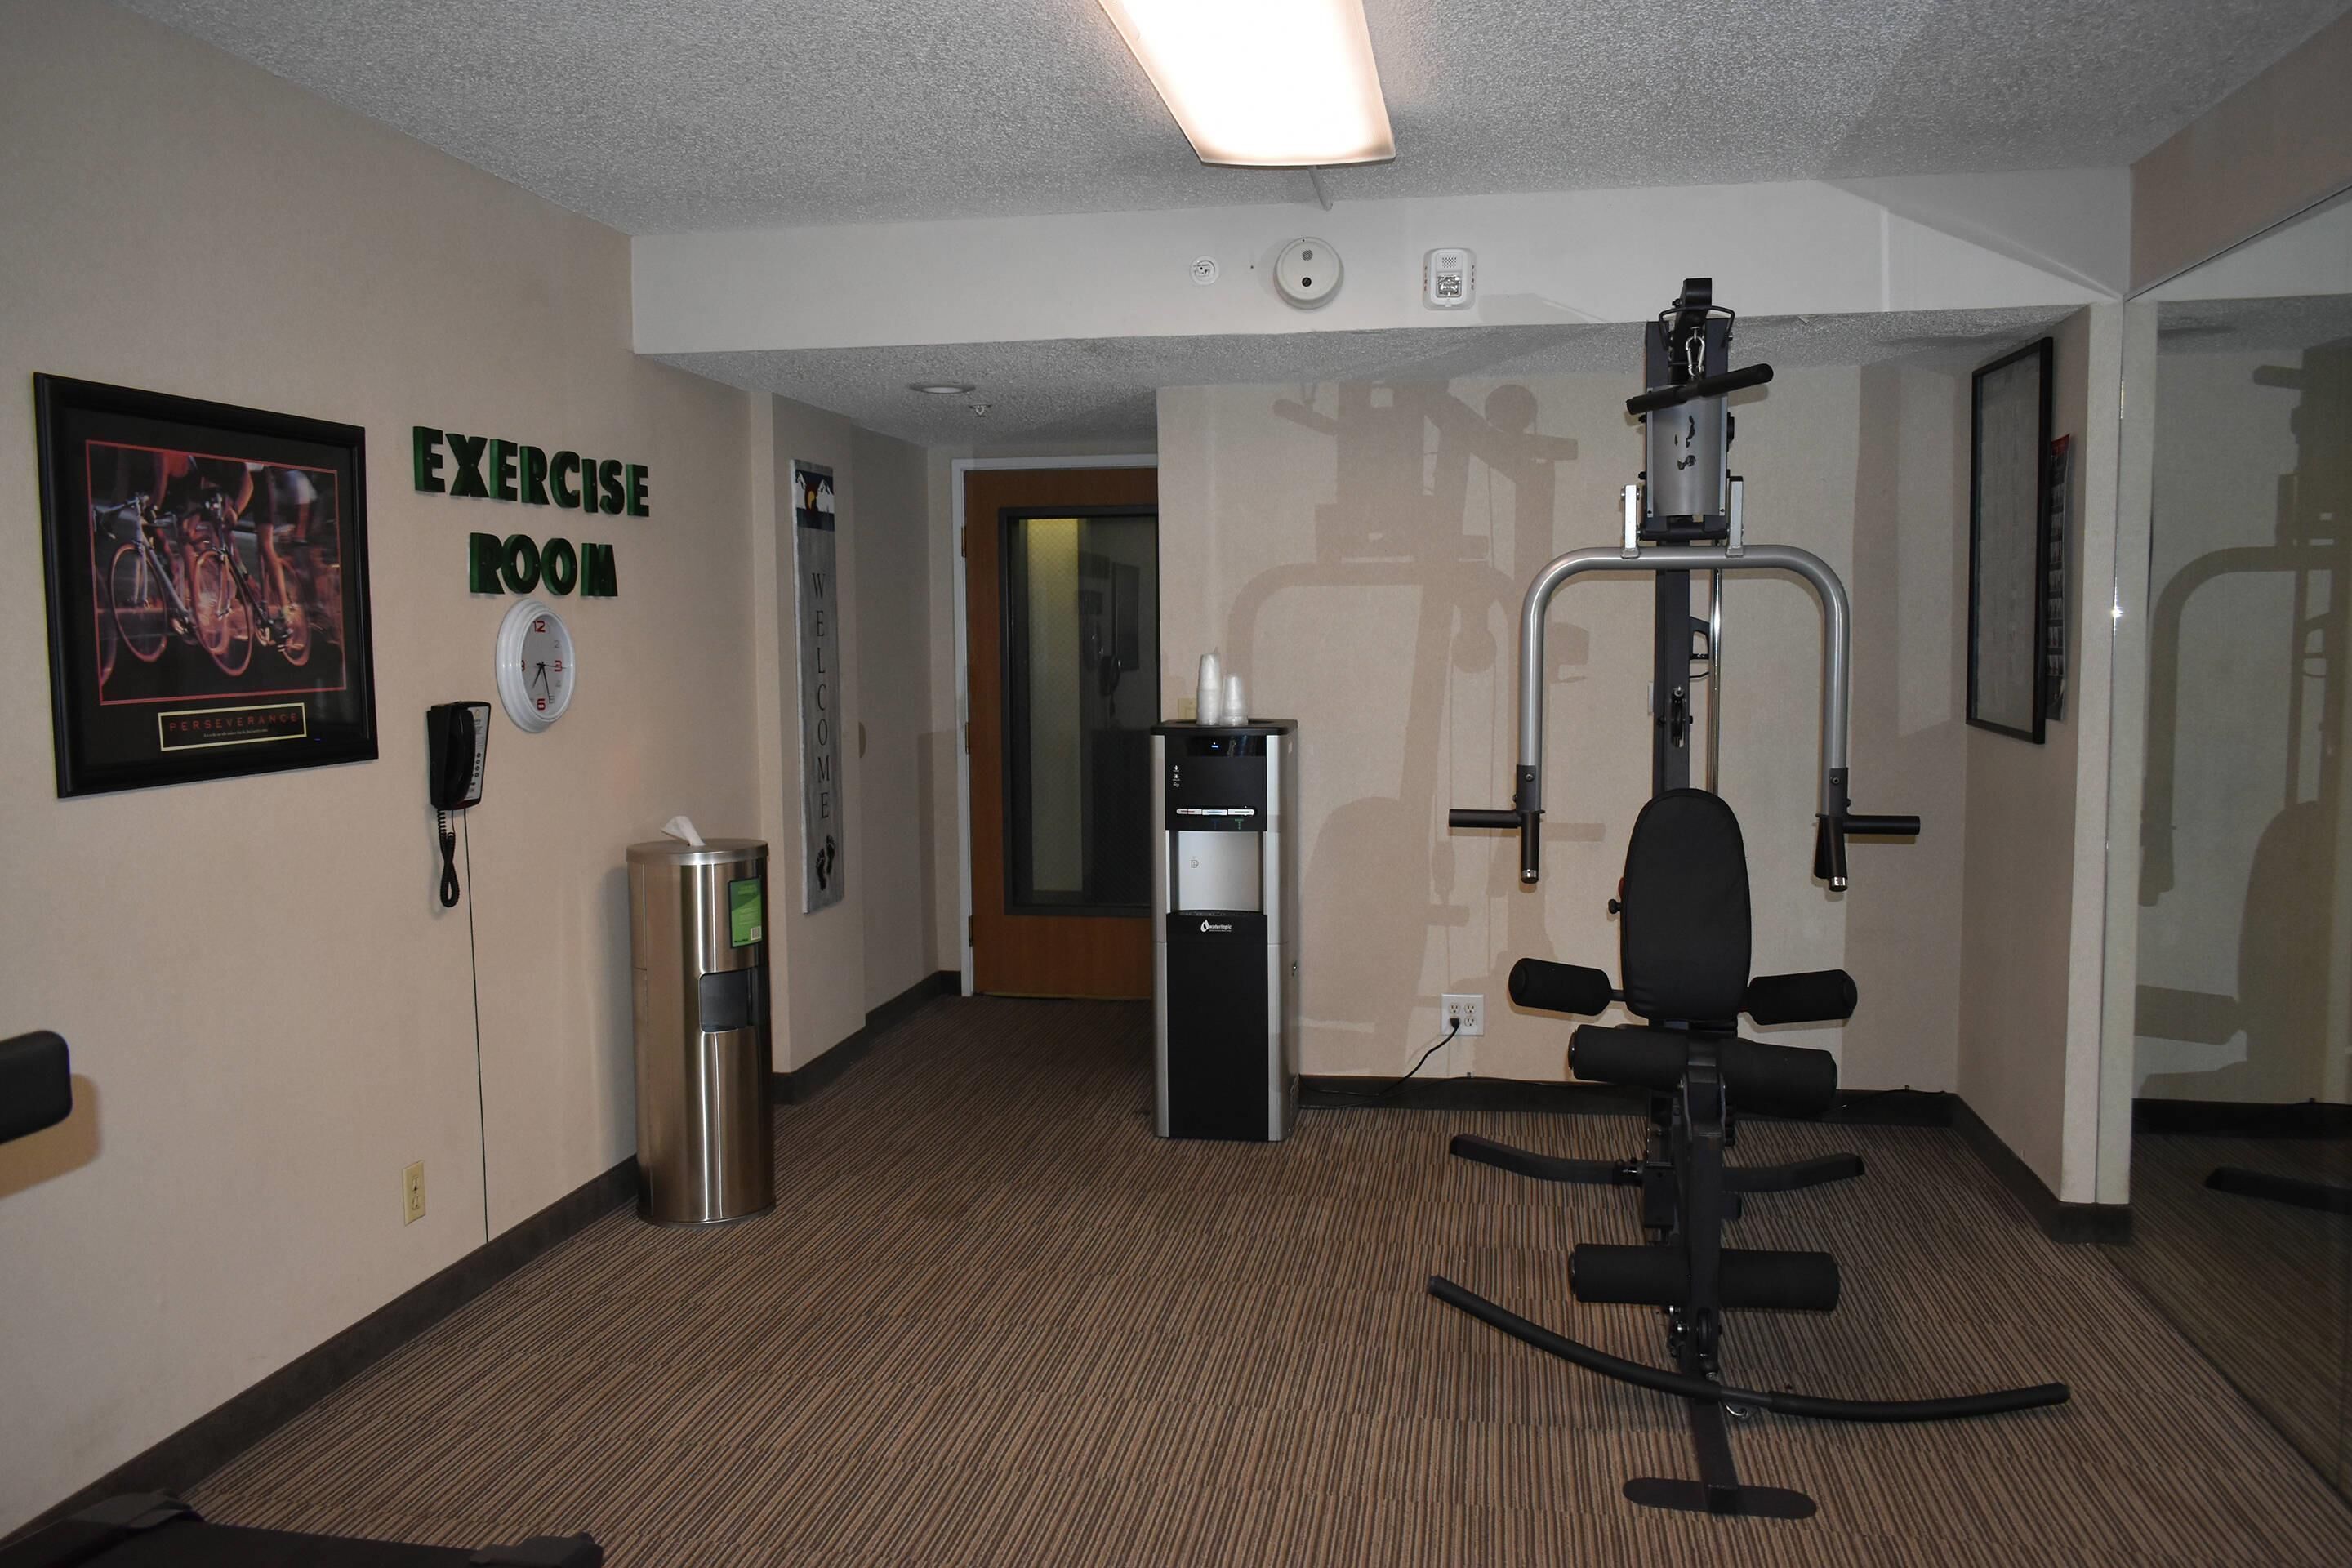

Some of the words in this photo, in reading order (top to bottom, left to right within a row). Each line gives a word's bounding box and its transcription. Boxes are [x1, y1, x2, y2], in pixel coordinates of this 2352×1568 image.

[412, 425, 650, 517] EXERCISE
[470, 532, 618, 597] ROOM
[533, 621, 546, 633] 12
[537, 698, 546, 710] 6
[811, 572, 830, 818] WELCOME
[169, 712, 298, 732] PERSEVERANCE
